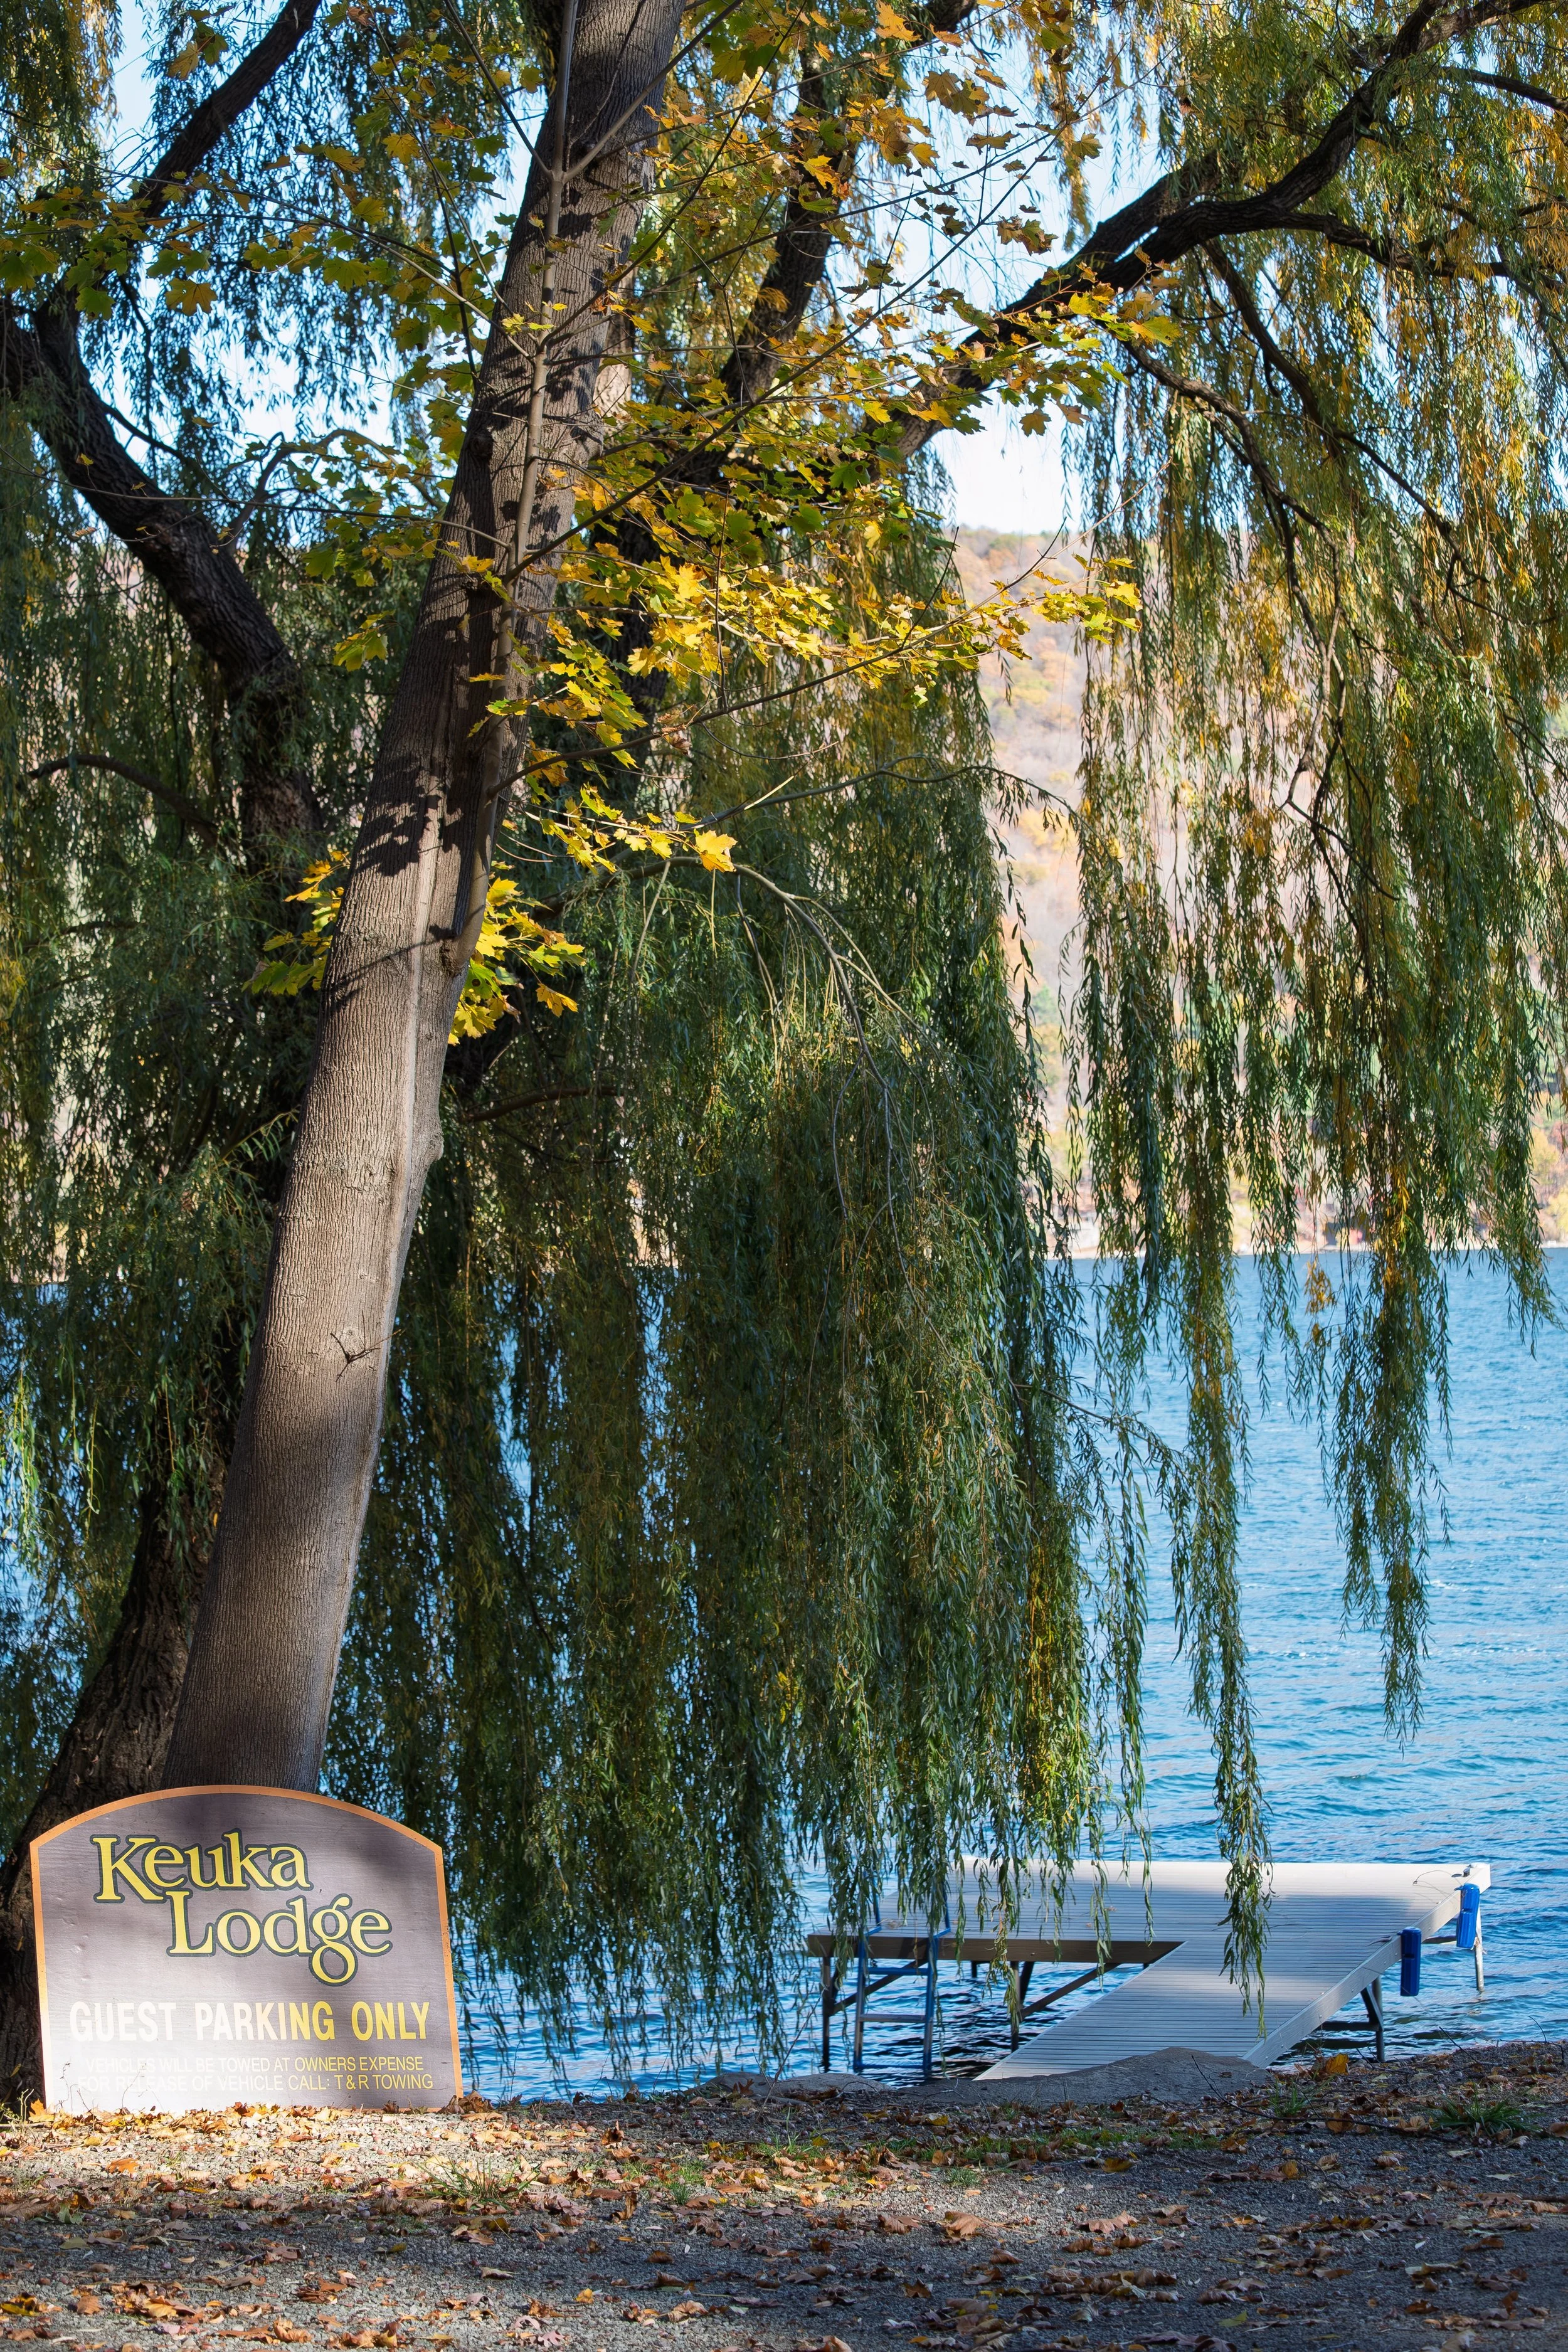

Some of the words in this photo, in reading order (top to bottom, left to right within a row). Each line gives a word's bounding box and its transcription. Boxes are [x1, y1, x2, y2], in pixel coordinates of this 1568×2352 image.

[90, 1829, 314, 1903] Keuka
[167, 1890, 392, 1986] Lodge
[72, 2001, 177, 2042] GUEST
[196, 2001, 335, 2040] PARKING
[352, 2001, 430, 2040] ONLY
[78, 2077, 110, 2092] FOR
[115, 2076, 187, 2092] RELEASE
[192, 2076, 213, 2092] OF
[218, 2075, 283, 2090] VEHICLE
[288, 2075, 331, 2090] CALL:
[371, 2074, 433, 2089] TOWING
[87, 2058, 155, 2073] VEHICLES
[159, 2058, 193, 2072] WILL
[196, 2058, 213, 2072] BE
[218, 2057, 270, 2072] TOWED
[273, 2057, 292, 2072] AT
[295, 2057, 356, 2072] OWNERS
[359, 2057, 423, 2071] EXPENSE
